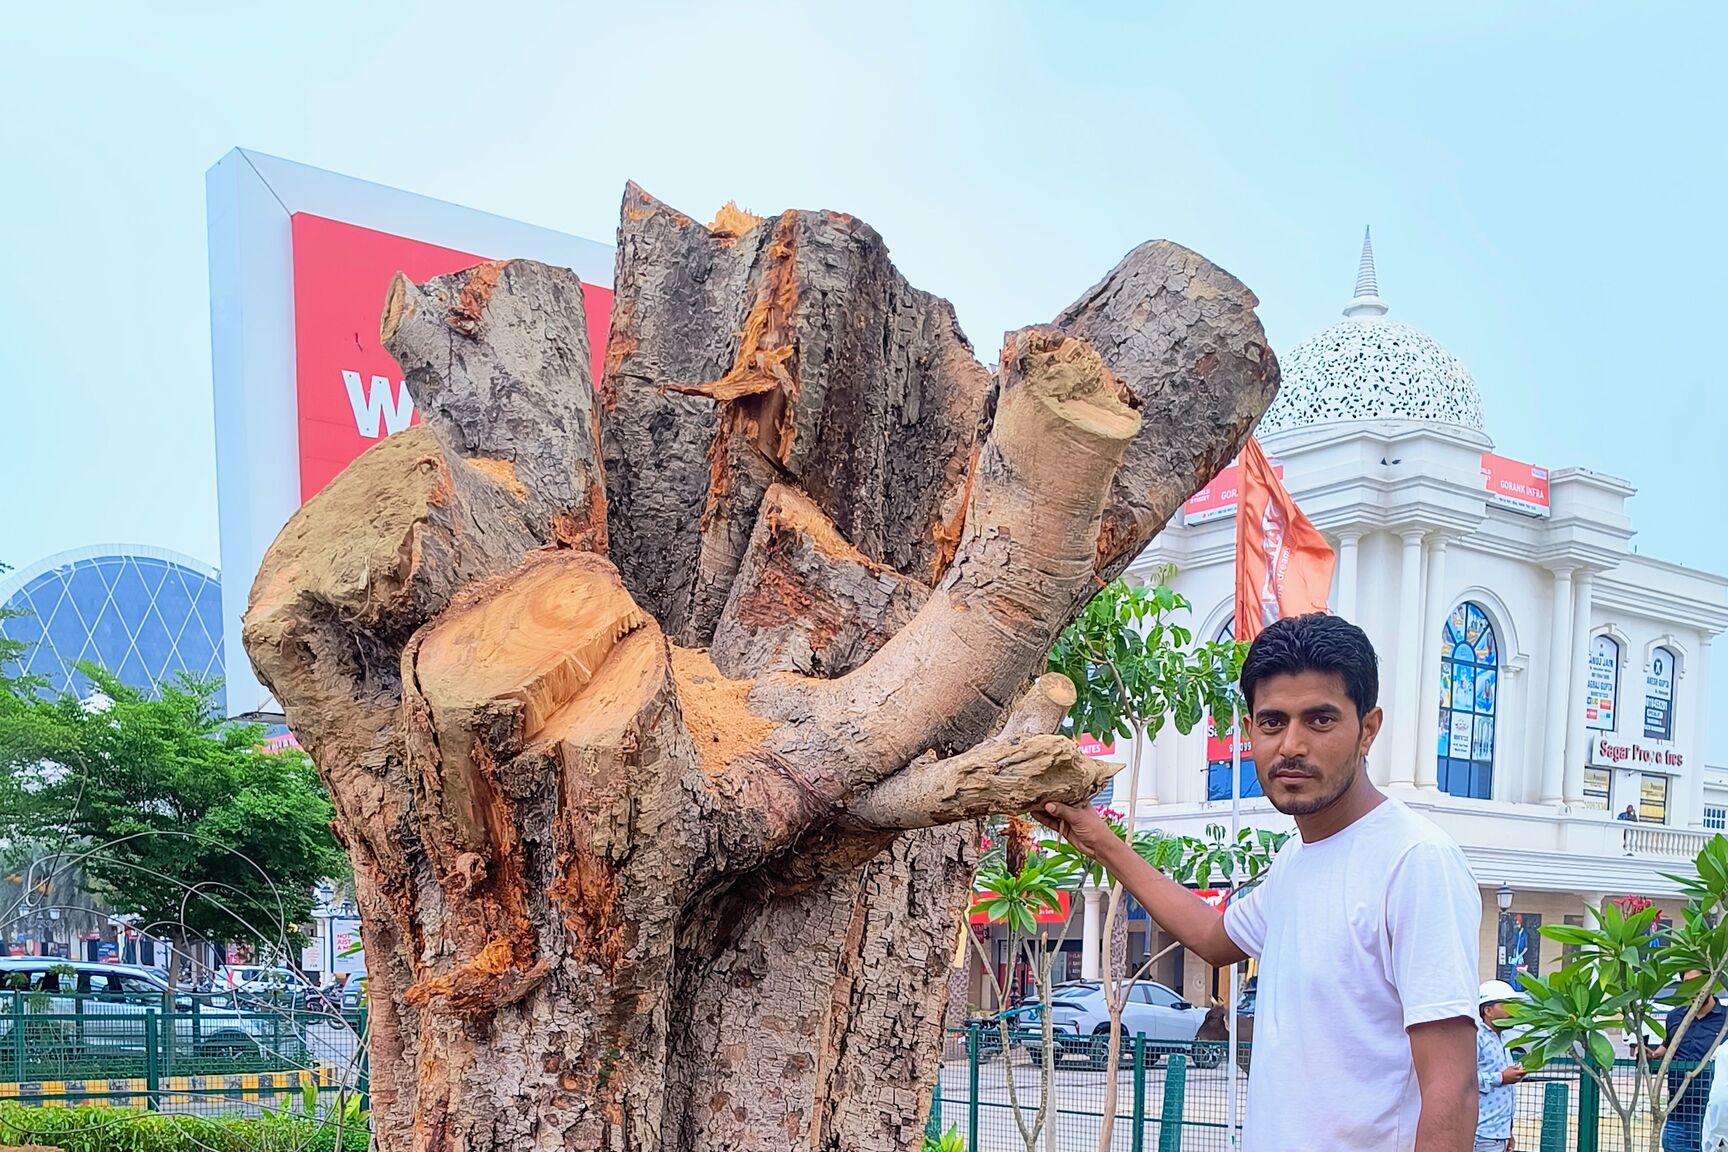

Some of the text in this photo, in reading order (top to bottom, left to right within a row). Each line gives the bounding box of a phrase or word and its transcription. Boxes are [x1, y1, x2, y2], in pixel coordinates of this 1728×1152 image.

[1221, 488, 1238, 500] GOR
[1207, 725, 1235, 738] Saar
[1599, 739, 1630, 762] Sagar
